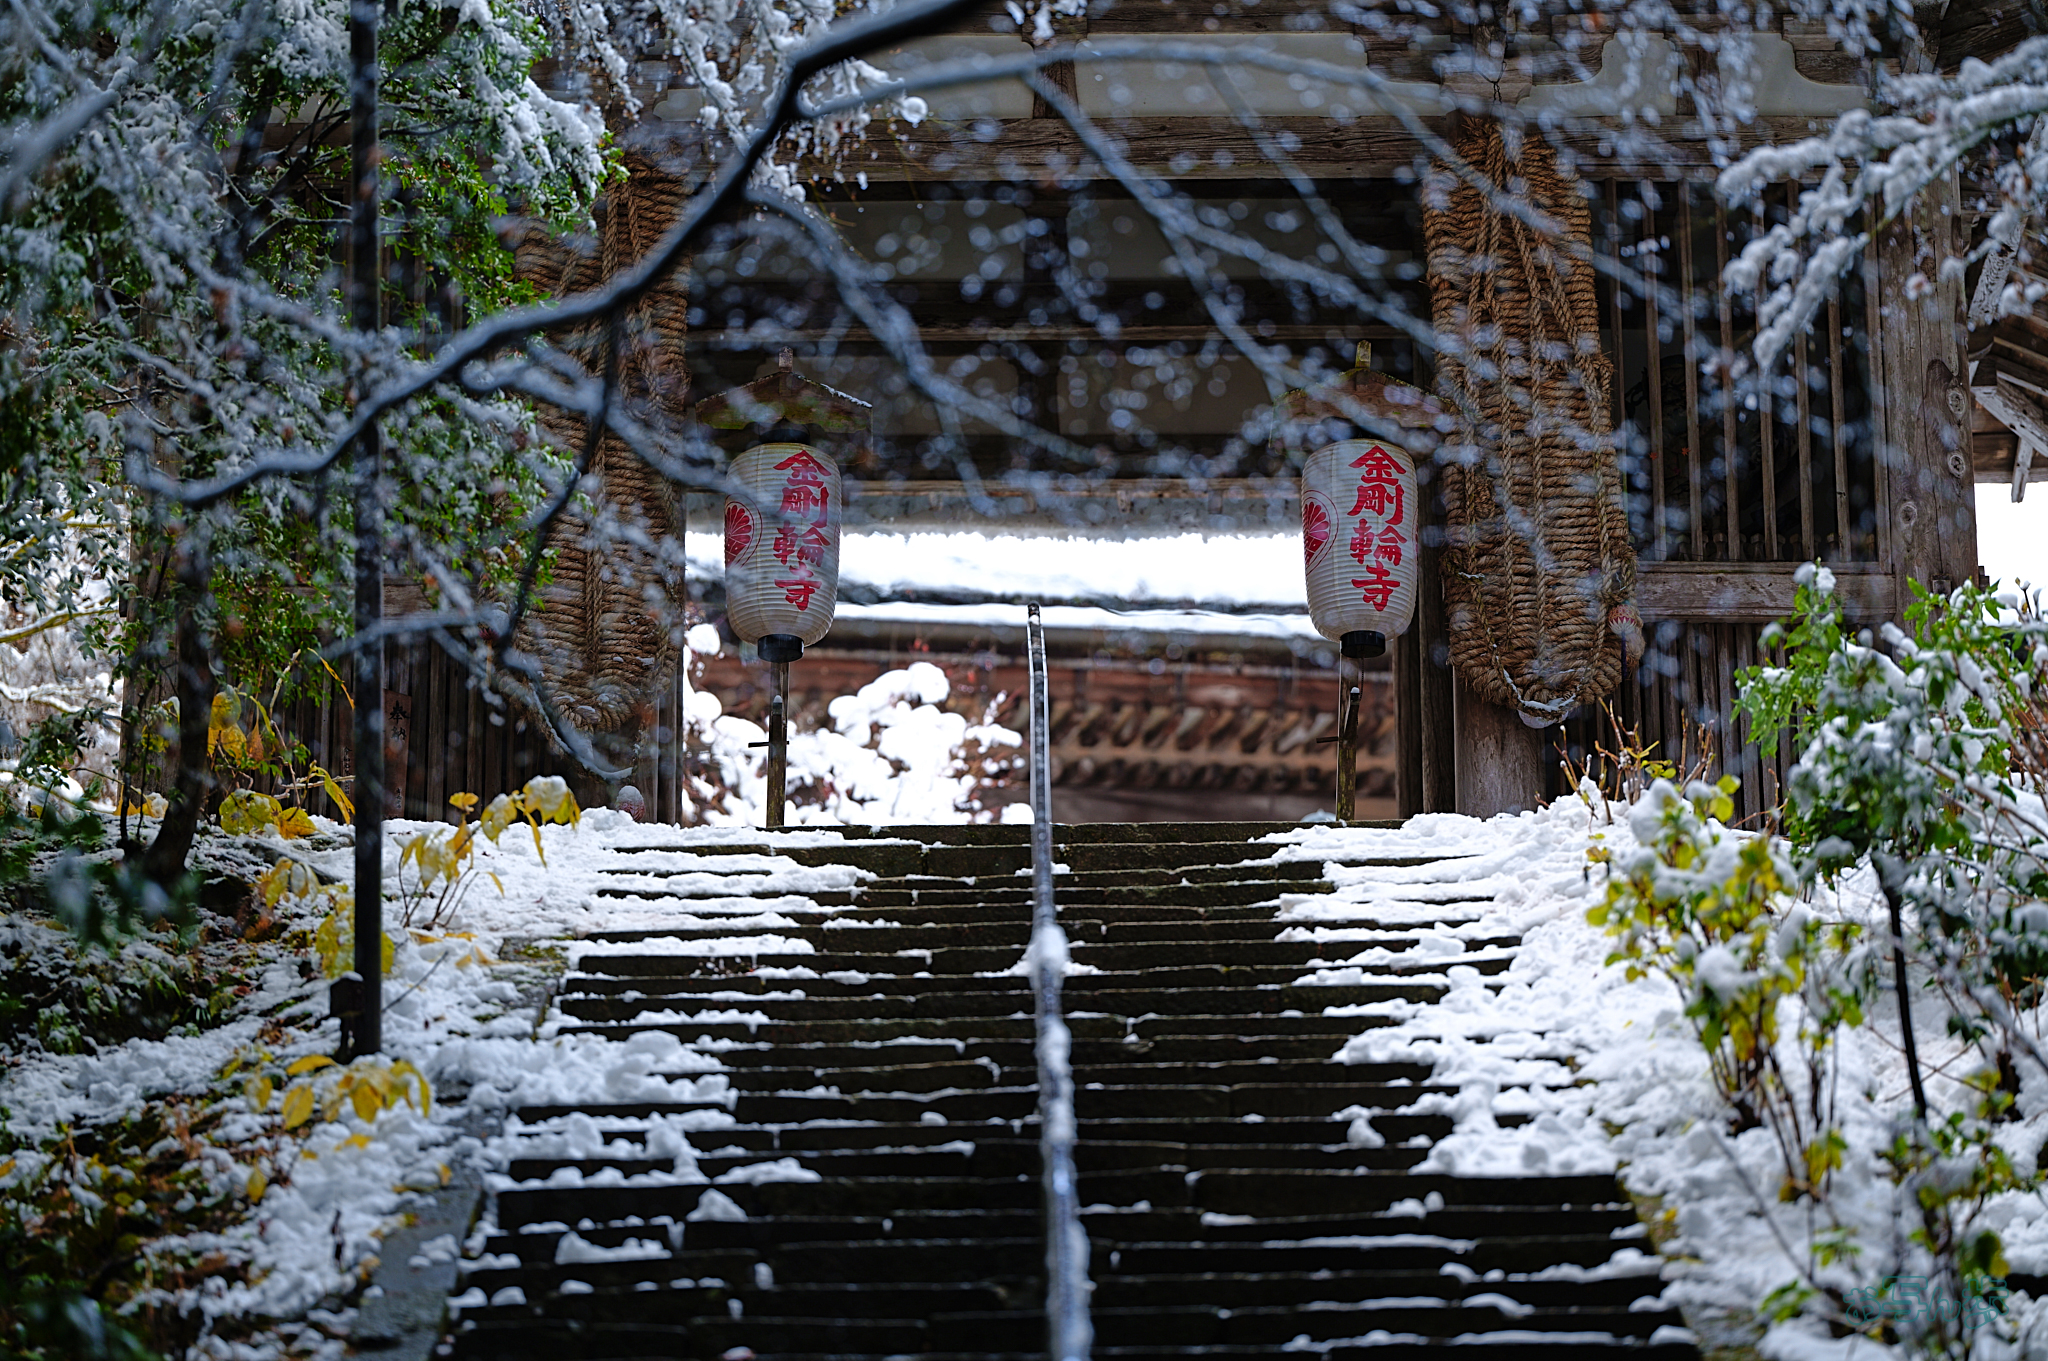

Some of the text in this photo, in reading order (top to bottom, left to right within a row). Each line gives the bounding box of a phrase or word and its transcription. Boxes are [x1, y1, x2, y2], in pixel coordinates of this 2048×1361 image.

[773, 450, 831, 611] 金剛輪寺
[1348, 445, 1407, 612] 金剛輪寺
[388, 700, 411, 741] 奉納
